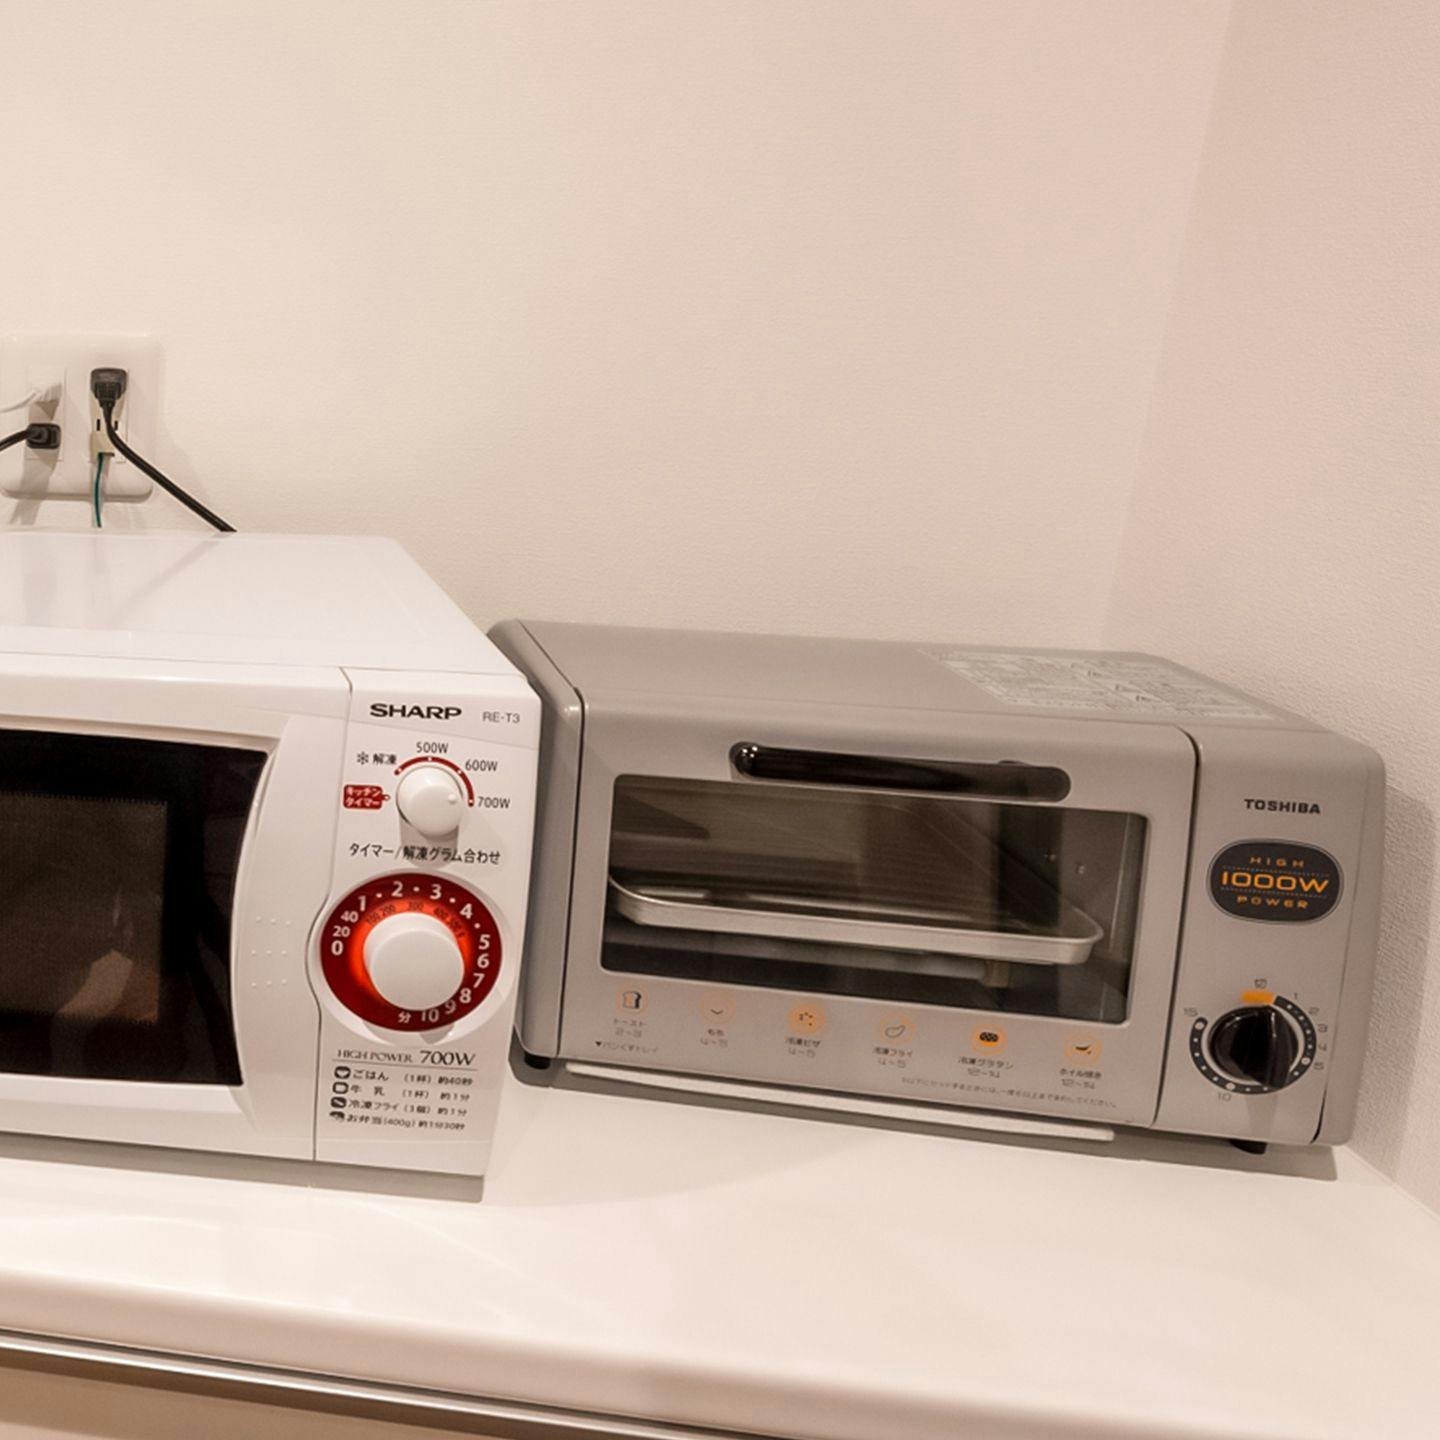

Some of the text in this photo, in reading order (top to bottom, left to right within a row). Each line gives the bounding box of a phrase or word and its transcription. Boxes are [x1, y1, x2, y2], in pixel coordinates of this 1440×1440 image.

[369, 703, 521, 724] SHARP RE-T3
[416, 742, 449, 754] 500W
[372, 753, 397, 765] 解凍
[465, 760, 498, 772] 600W
[478, 796, 511, 809] 700W
[1243, 799, 1322, 814] TOSHIBA
[1249, 857, 1304, 867] HIGH
[391, 881, 403, 897] 2
[1221, 871, 1329, 893] 1000W
[430, 884, 442, 900] 3
[358, 896, 367, 911] 1
[1236, 896, 1309, 909] POWER
[340, 911, 359, 923] 40
[459, 903, 473, 919] 4
[333, 925, 351, 937] 20
[331, 940, 344, 956] 0
[478, 934, 490, 950] 5
[477, 953, 490, 968] 6
[472, 973, 485, 988] 7
[459, 988, 472, 1003] 8
[444, 999, 457, 1015] 9
[420, 1007, 440, 1023] 10
[337, 1049, 476, 1066] HIGH POWER 700W
[352, 1069, 389, 1082] ごはん
